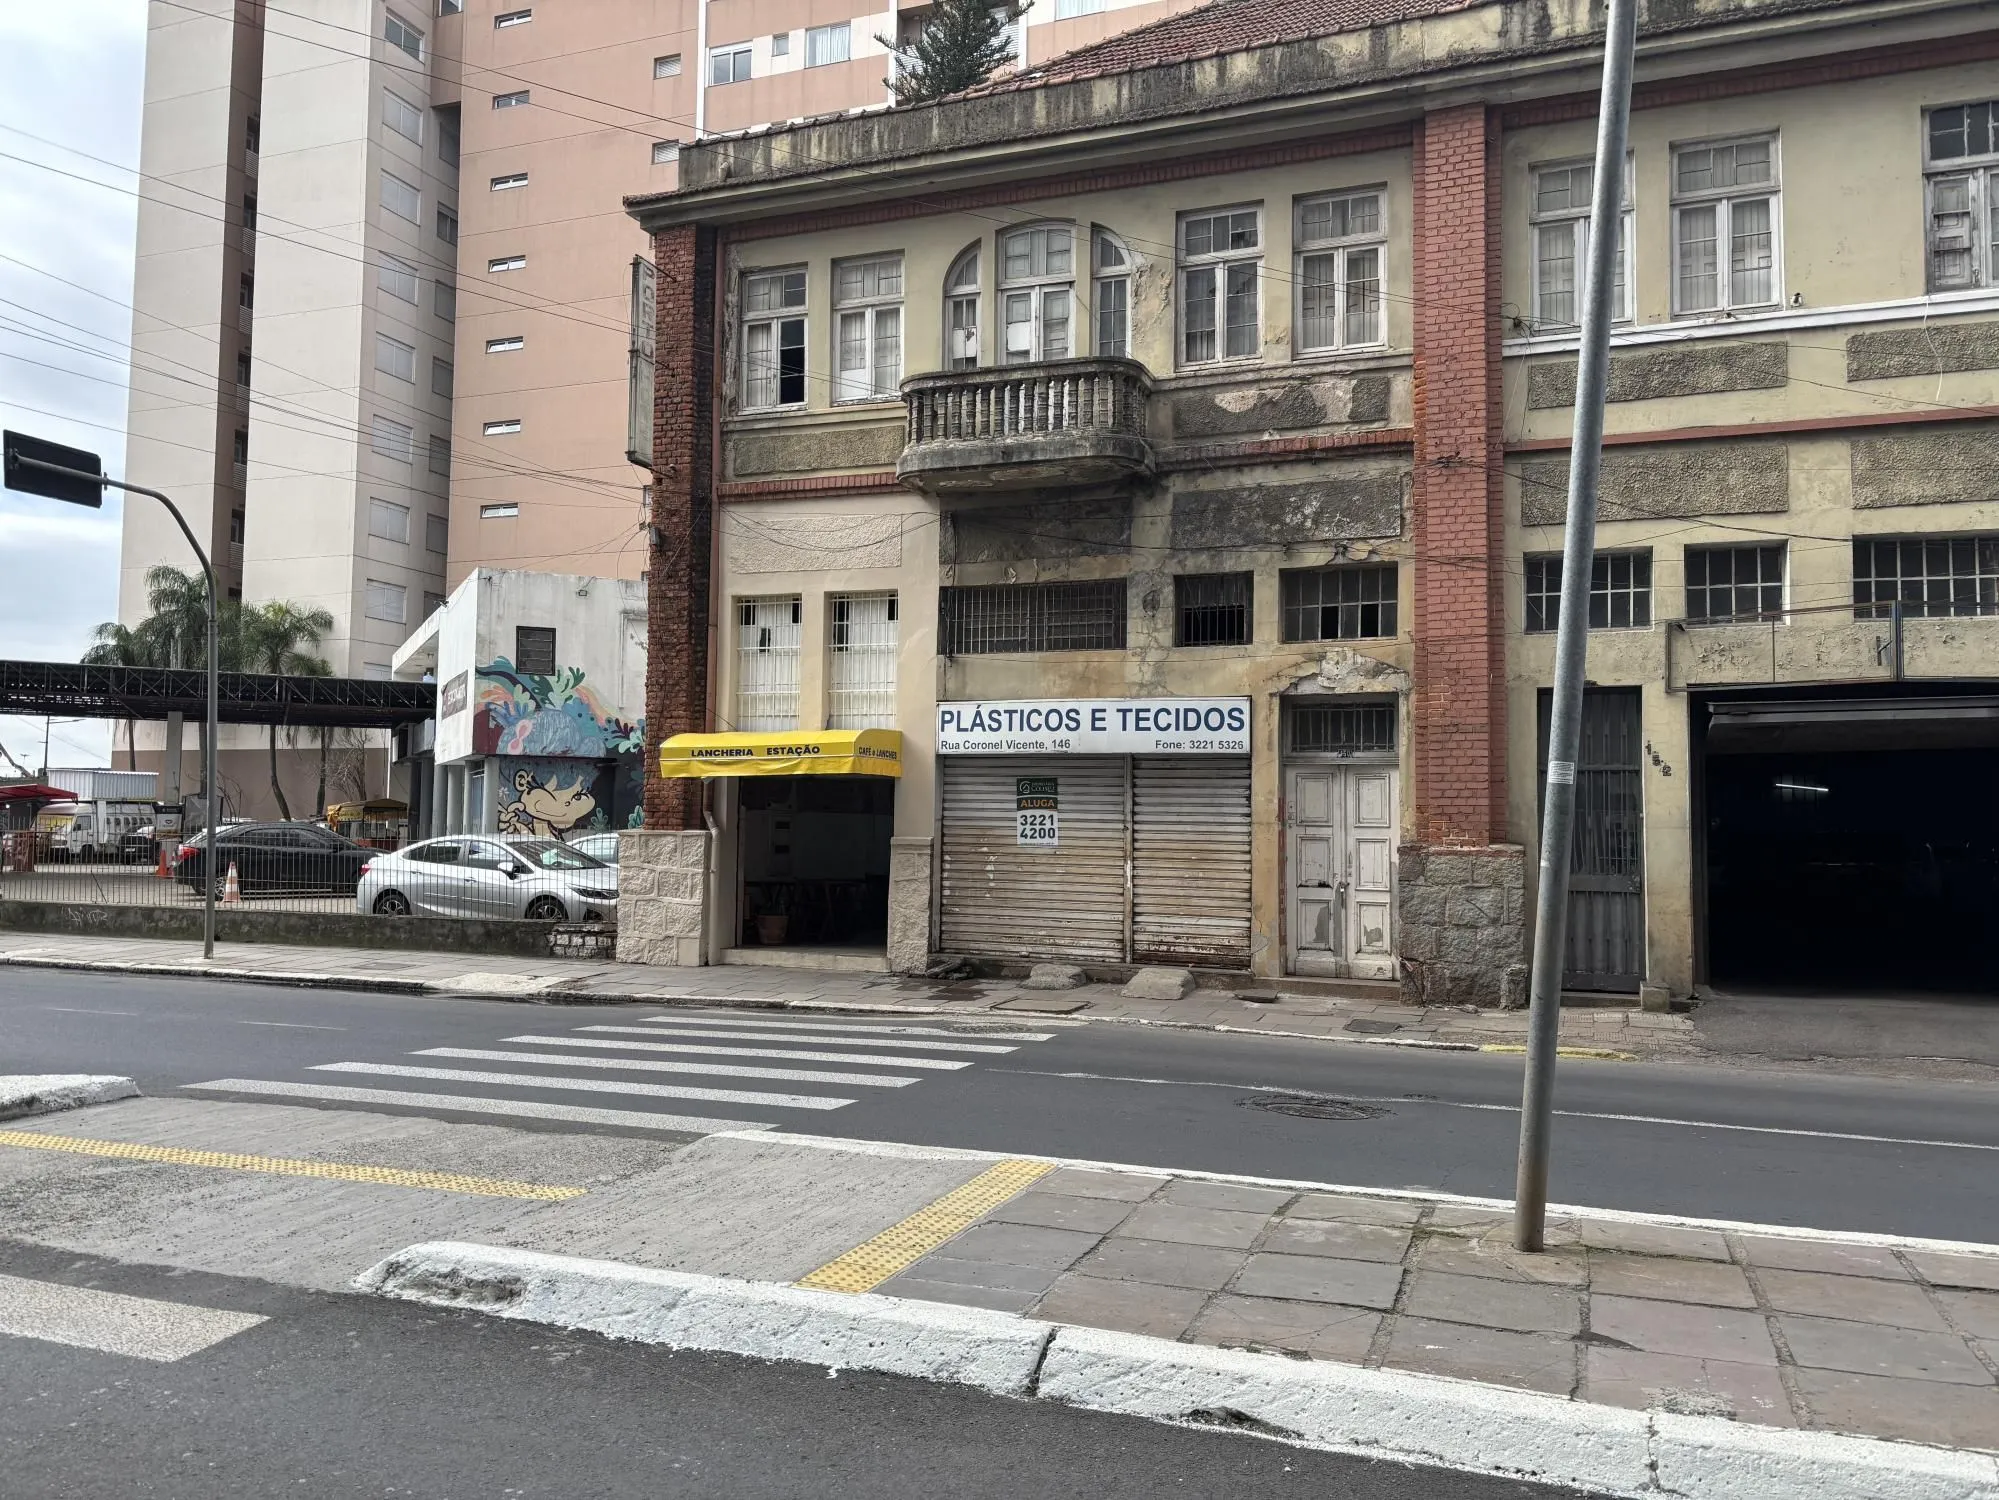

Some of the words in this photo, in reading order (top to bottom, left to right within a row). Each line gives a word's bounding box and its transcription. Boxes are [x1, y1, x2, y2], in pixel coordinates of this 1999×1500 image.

[940, 704, 1081, 733] PLÁSTICOS
[1091, 708, 1107, 732] E
[1116, 707, 1245, 732] TECIDOS
[691, 748, 754, 757] LANCHERIA
[766, 745, 820, 757] ESTAÇÃO
[941, 740, 961, 749] Rua
[963, 739, 1003, 749] Coronel
[1005, 739, 1048, 751] Vicente,
[1051, 739, 1071, 749] 146
[1155, 740, 1186, 749] Fone:
[1189, 740, 1214, 749] 3221
[1218, 740, 1244, 750] 5326
[1020, 799, 1055, 808] ALUGA
[1020, 814, 1054, 826] 3221
[1020, 827, 1056, 839] 4200
